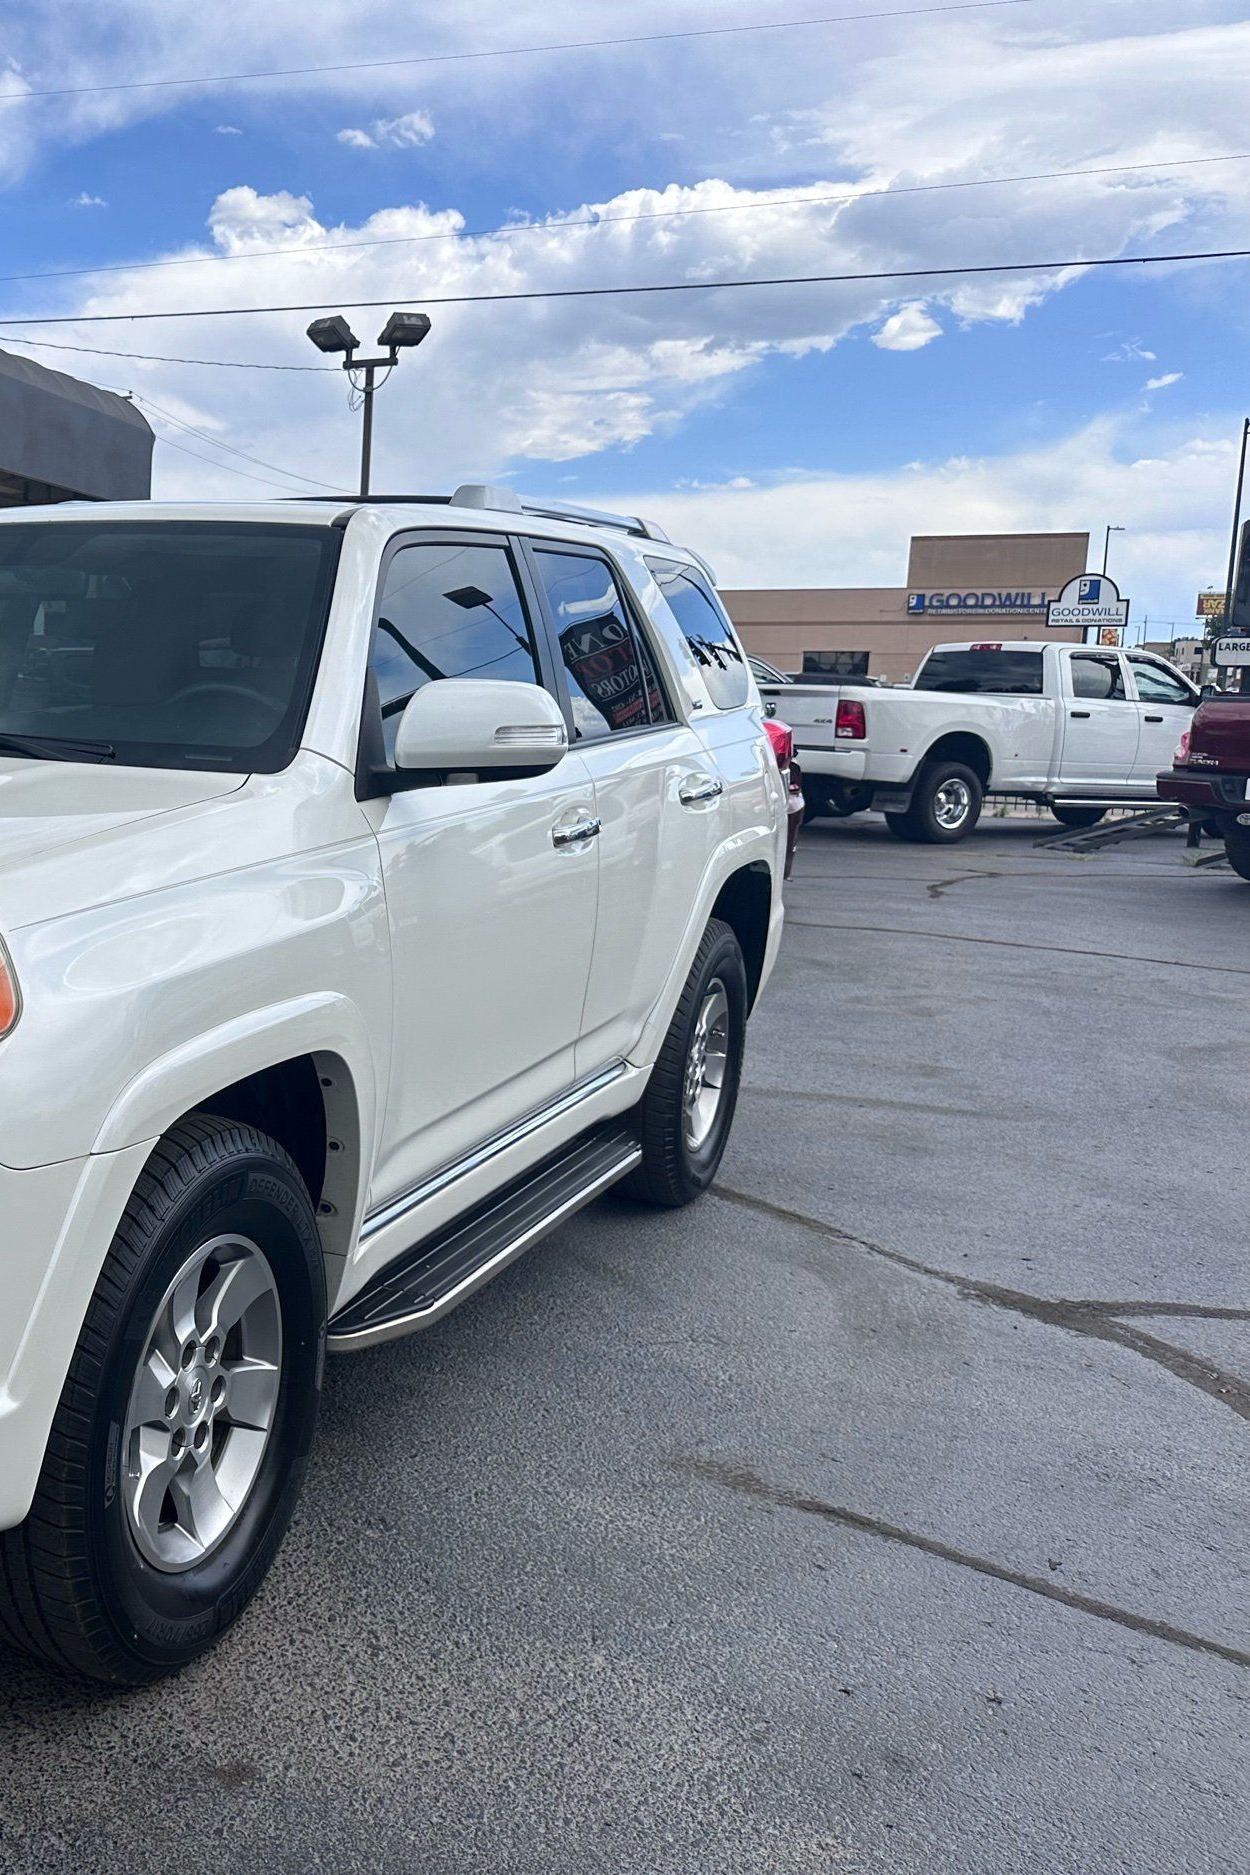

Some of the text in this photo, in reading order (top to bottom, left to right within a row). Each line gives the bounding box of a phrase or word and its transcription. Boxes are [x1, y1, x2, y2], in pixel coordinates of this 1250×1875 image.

[929, 592, 1048, 608] GOODWILL
[1051, 607, 1123, 617] GOODWILL
[250, 1178, 298, 1215] DEFENDER
